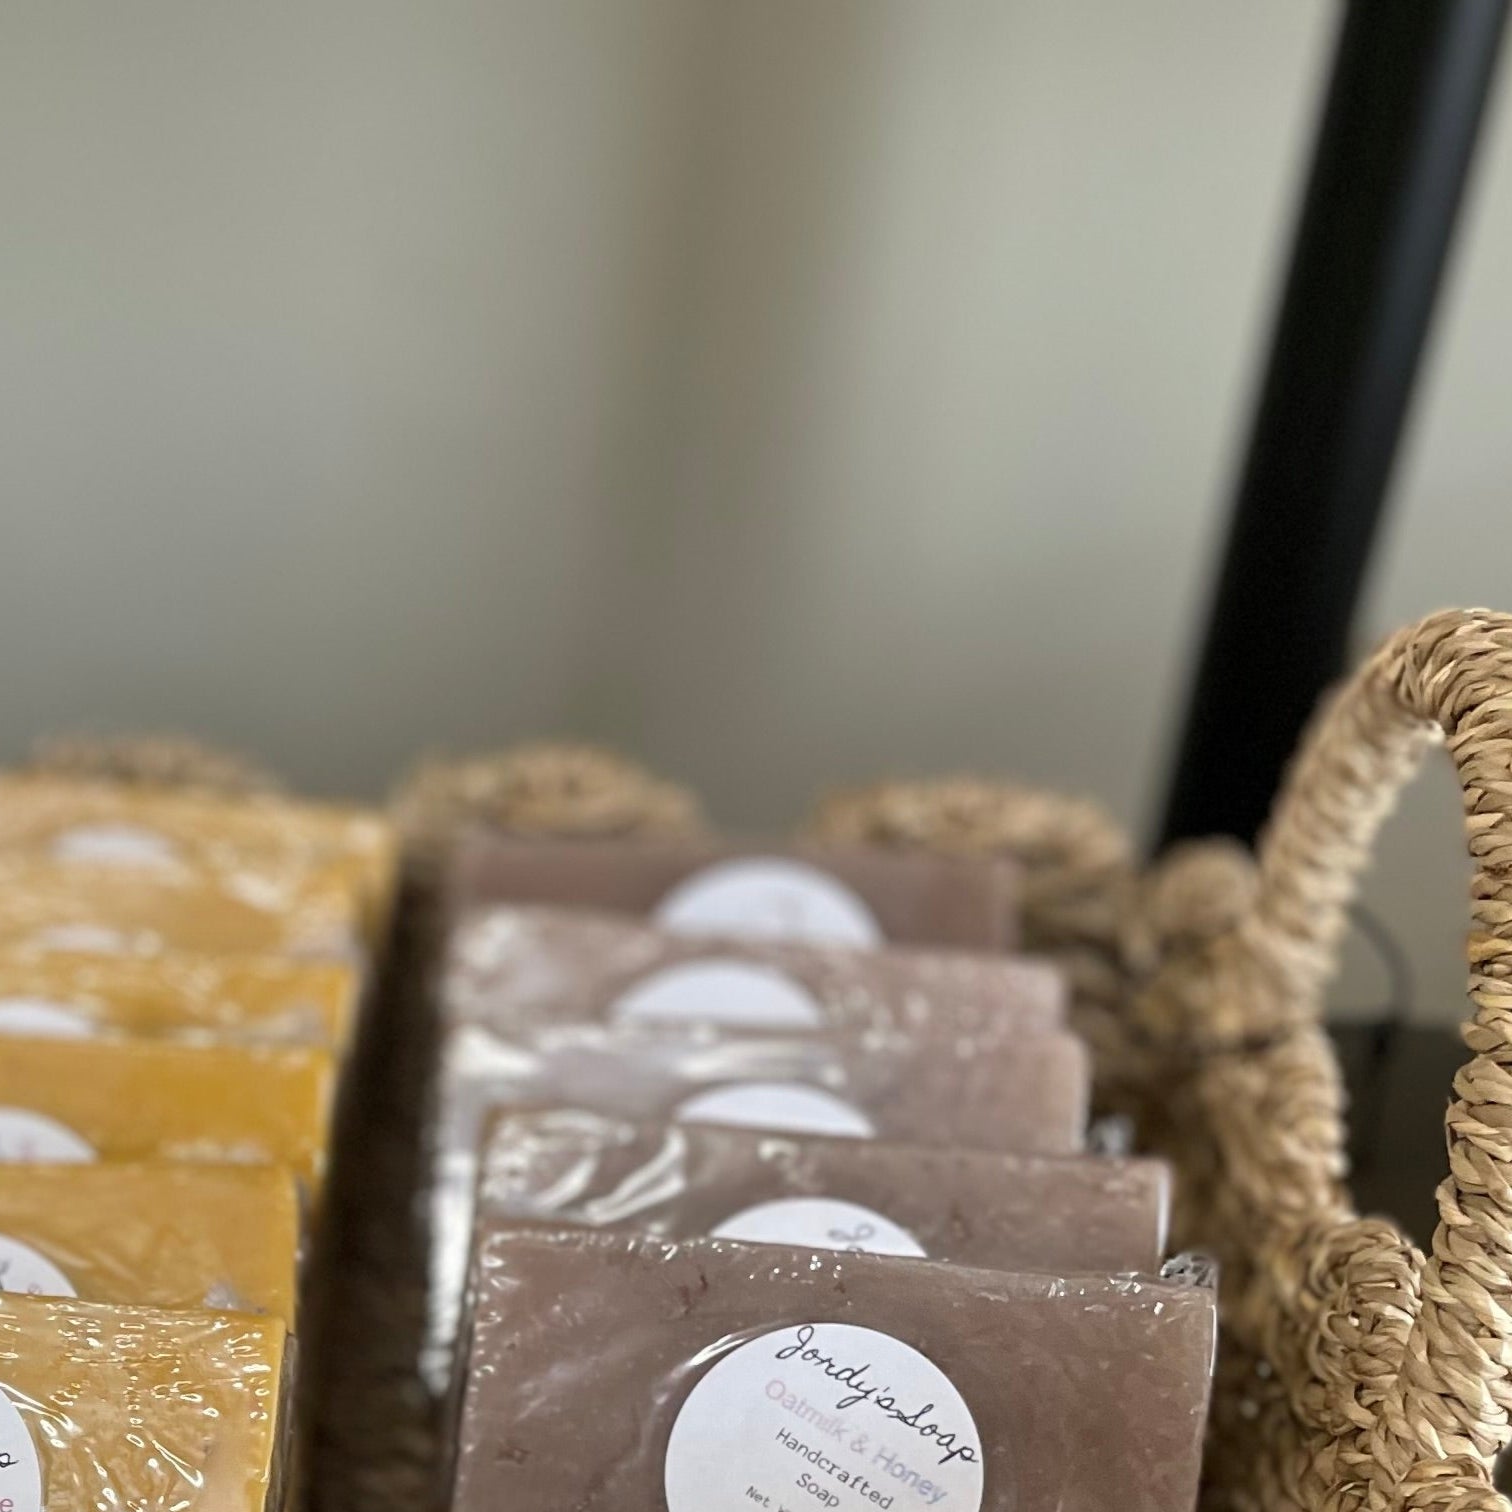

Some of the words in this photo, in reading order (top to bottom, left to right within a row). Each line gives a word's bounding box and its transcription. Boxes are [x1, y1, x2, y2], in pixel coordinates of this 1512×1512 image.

[775, 1427, 894, 1511] Handcrafted
[796, 1473, 841, 1509] Soap
[849, 1434, 869, 1456] &
[872, 1447, 948, 1506] Honey
[745, 1485, 771, 1508] Net
